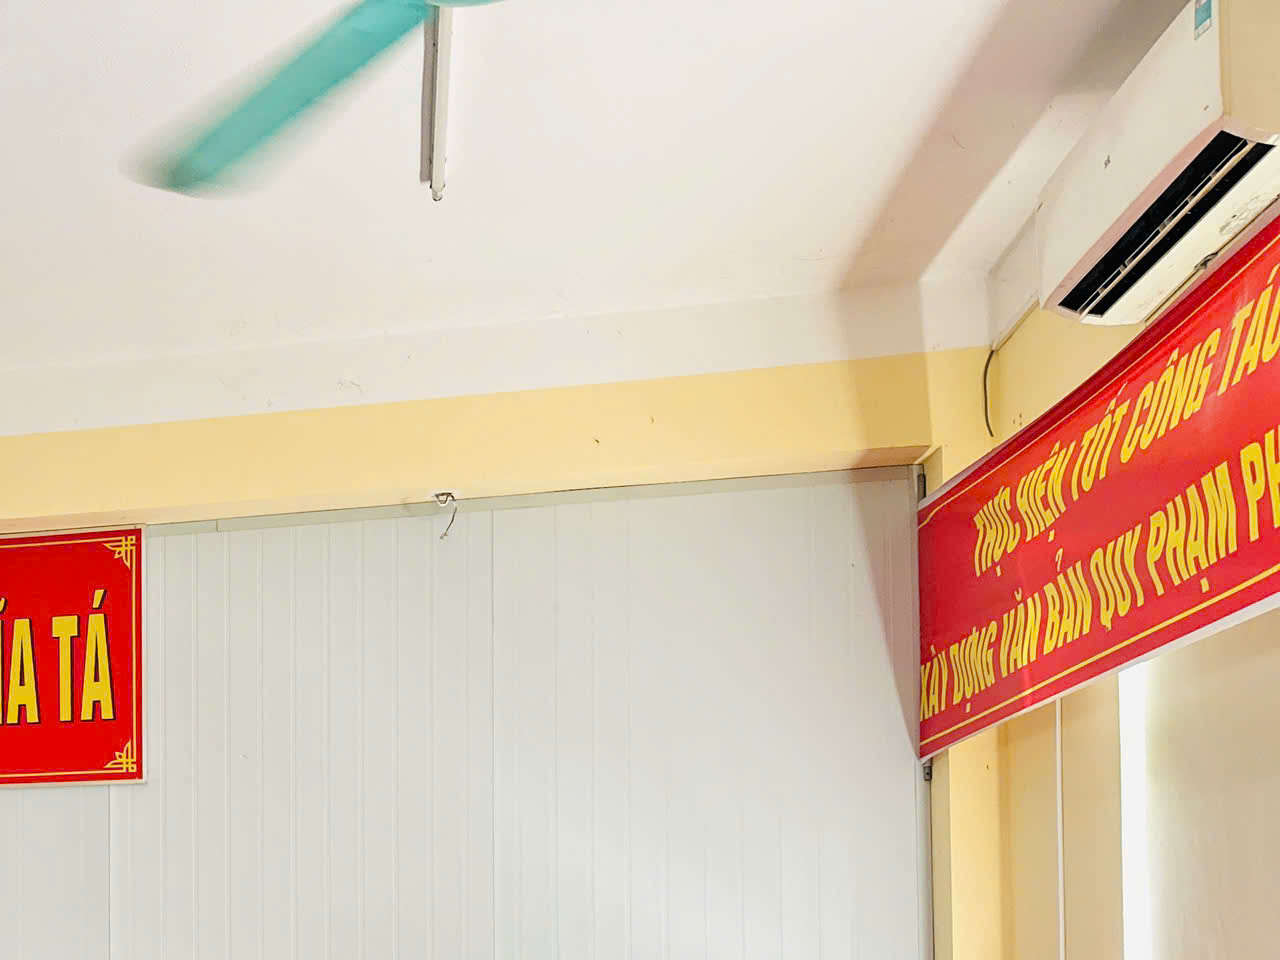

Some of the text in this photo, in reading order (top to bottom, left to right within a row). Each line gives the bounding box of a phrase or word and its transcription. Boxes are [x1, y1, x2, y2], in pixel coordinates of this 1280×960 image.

[973, 485, 1021, 577] THỰC
[1016, 440, 1076, 543] HIỆN
[1071, 381, 1131, 502] TỐT
[1120, 328, 1221, 464] CÔNG
[51, 588, 116, 723] TÁ
[949, 620, 998, 713] DỰNG
[999, 587, 1042, 678] VĂN
[1043, 548, 1092, 655] BẢN
[1090, 523, 1144, 631] QUY
[1147, 461, 1237, 593] PHẠM
